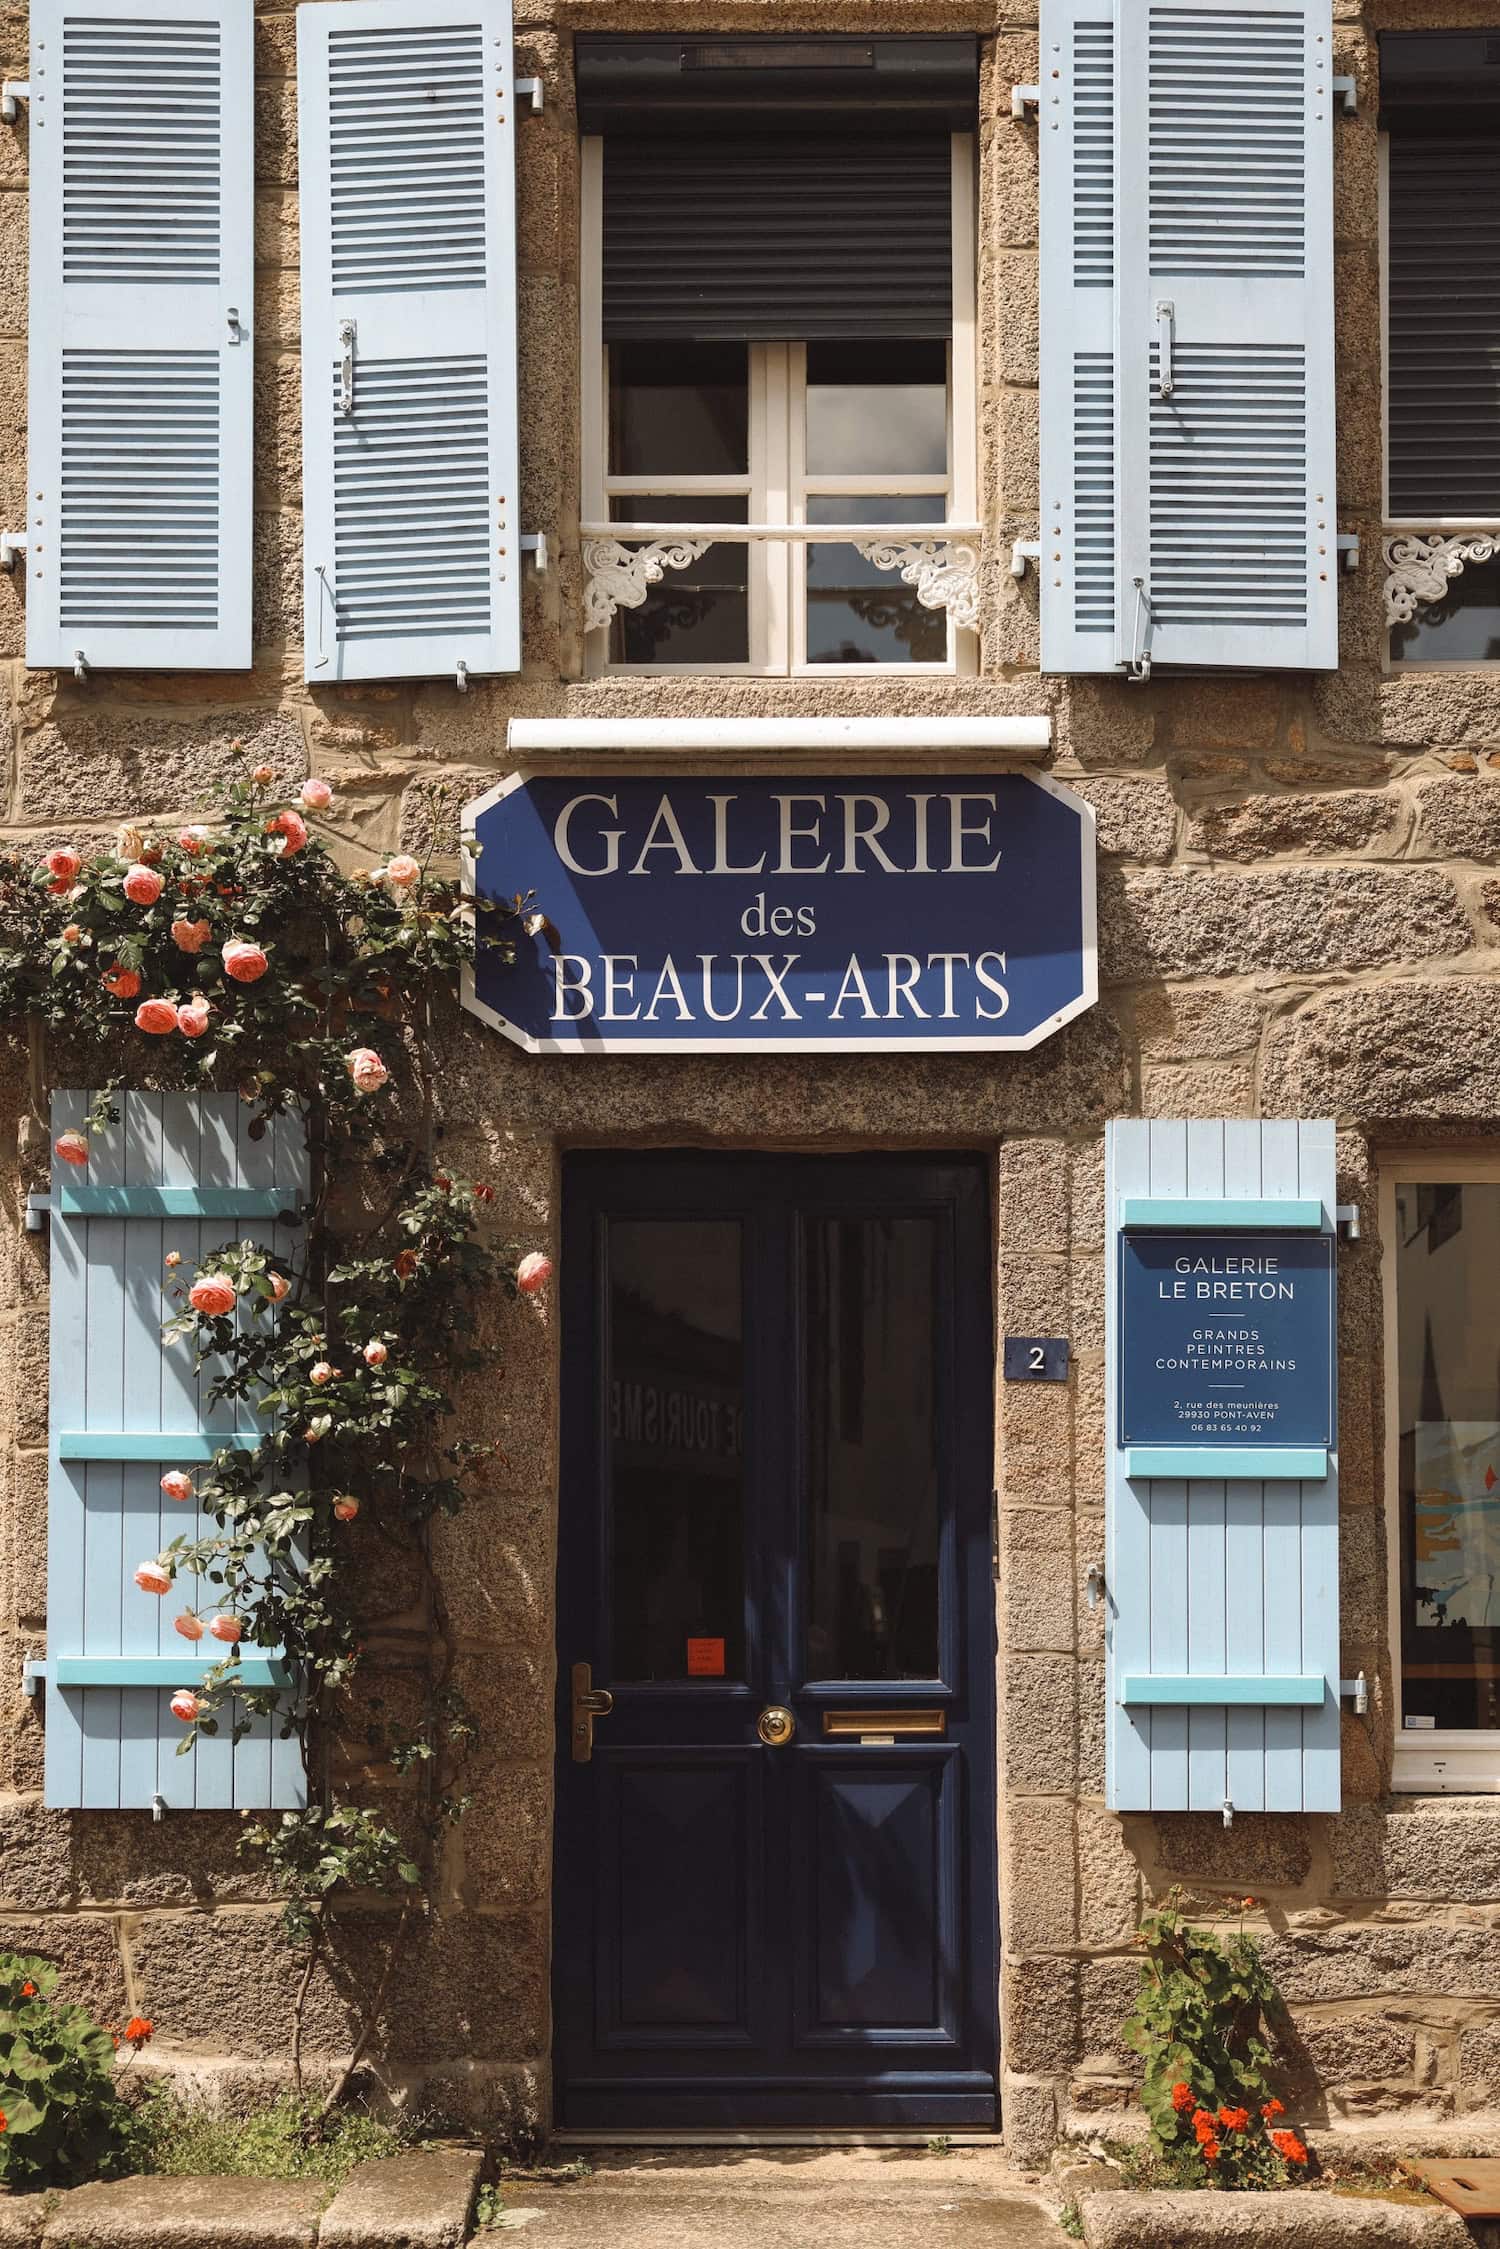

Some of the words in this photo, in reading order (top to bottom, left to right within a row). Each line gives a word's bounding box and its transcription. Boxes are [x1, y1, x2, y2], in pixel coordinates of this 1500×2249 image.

[553, 793, 1002, 876] GALERIE
[740, 892, 817, 937] des
[548, 951, 1011, 1021] BEAUX-ARTS
[1175, 1257, 1278, 1274] GALERIE
[1159, 1281, 1187, 1299] LE
[1196, 1282, 1294, 1300] BRETON
[1192, 1329, 1260, 1341] GRANDS
[1187, 1344, 1265, 1355] PEINTRES
[1029, 1347, 1045, 1370] 2
[1155, 1358, 1297, 1370] CONTEMPORAINS
[1206, 1400, 1224, 1409] des
[1178, 1411, 1211, 1419] 29930
[1214, 1411, 1275, 1420] PONT-AVEN
[1191, 1424, 1204, 1432] 06
